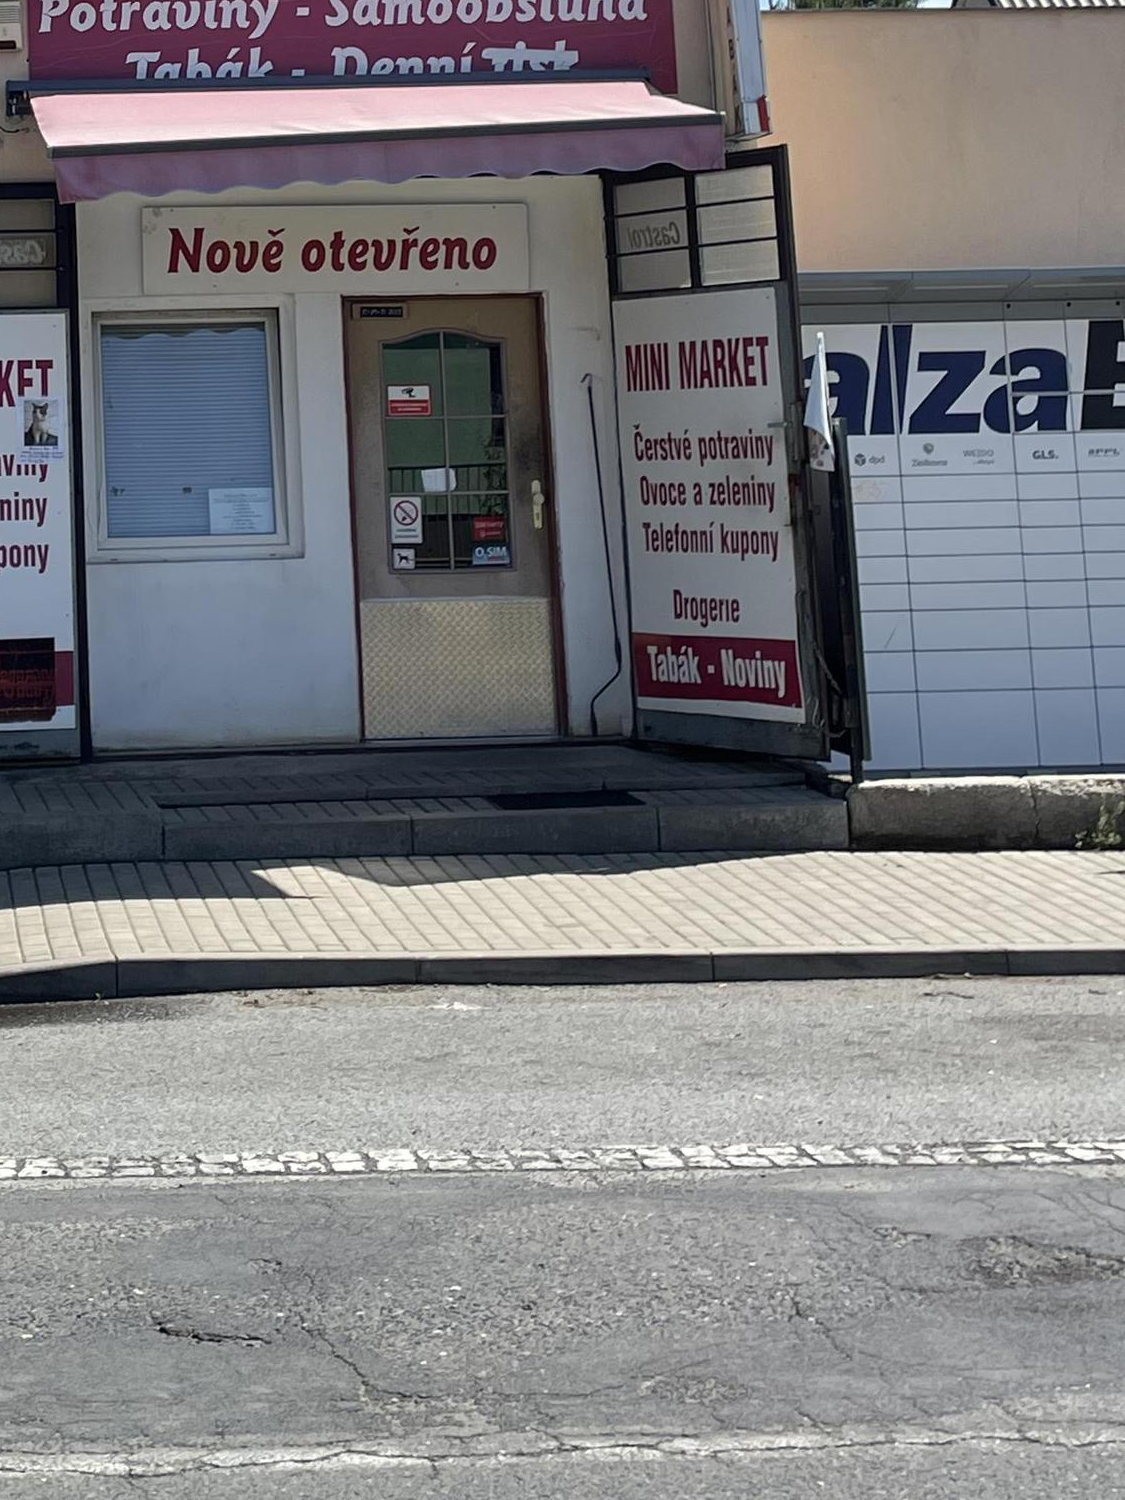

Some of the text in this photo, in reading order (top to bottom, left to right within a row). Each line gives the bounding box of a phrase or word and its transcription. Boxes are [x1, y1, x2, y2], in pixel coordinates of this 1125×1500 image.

[296, 7, 311, 18] -
[167, 225, 498, 274] Nově otevřeno
[625, 336, 769, 392] MINI MARKET
[634, 424, 774, 467] Čerstvé potraviny
[640, 475, 775, 513] Ovoce a zeleniny
[642, 521, 779, 562] Telefonní kupony
[673, 589, 741, 628] Drogerie
[647, 645, 702, 685] Tabák
[720, 649, 786, 699] Noviny
